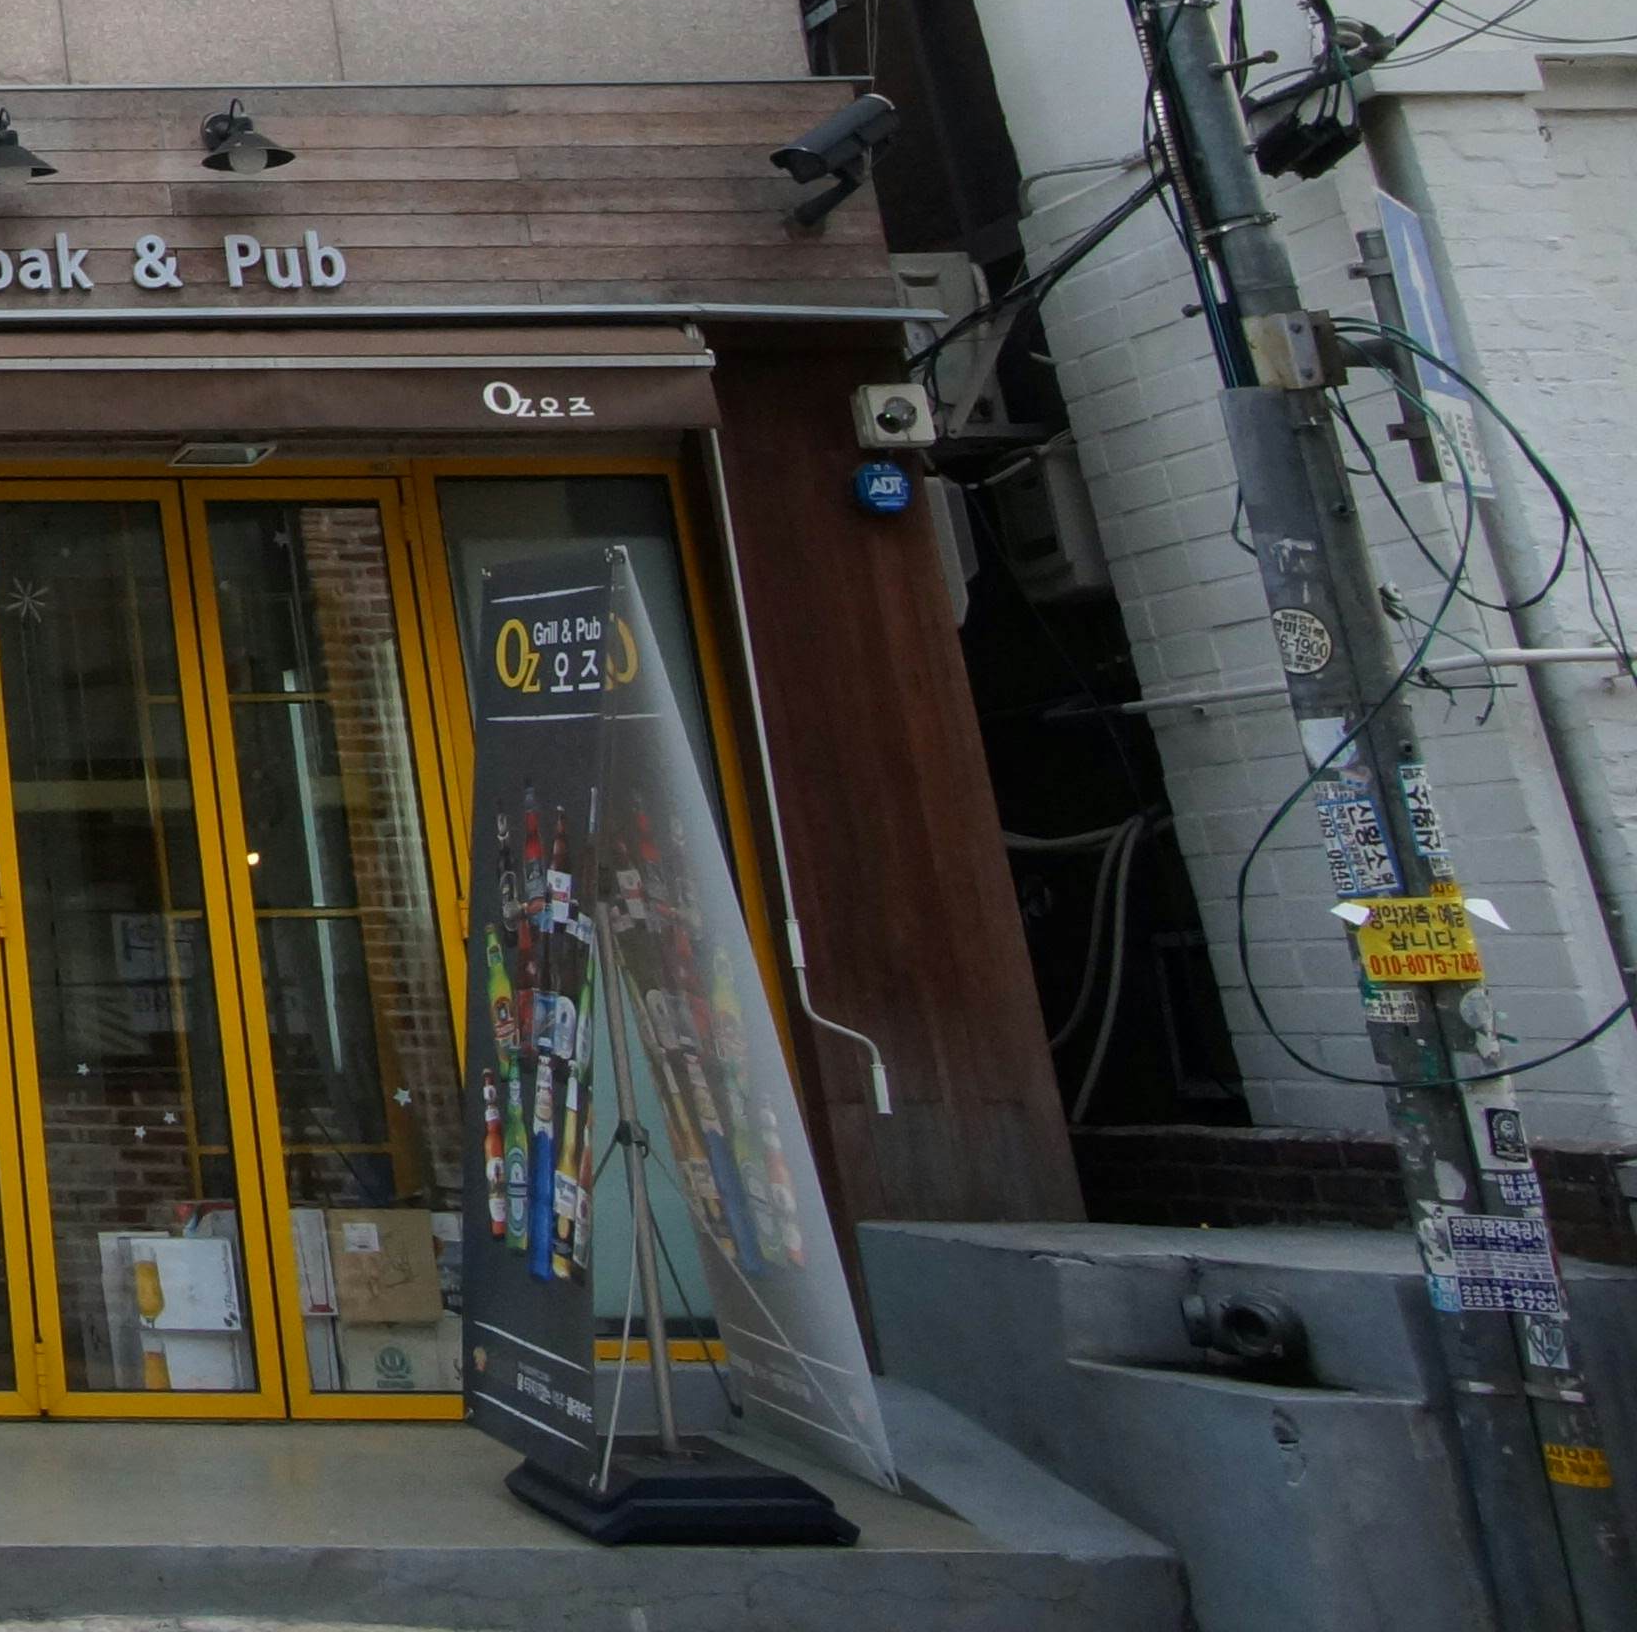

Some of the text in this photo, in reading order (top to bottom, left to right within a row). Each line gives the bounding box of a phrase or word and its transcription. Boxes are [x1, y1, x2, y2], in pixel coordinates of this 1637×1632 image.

[133, 234, 183, 289] &
[227, 230, 348, 289] Pub
[869, 476, 903, 495] ADT
[533, 621, 558, 646] Grill
[561, 618, 572, 643] &
[575, 616, 602, 642] Pub
[550, 649, 602, 693] 오즈
[1388, 930, 1457, 951] 삽니다
